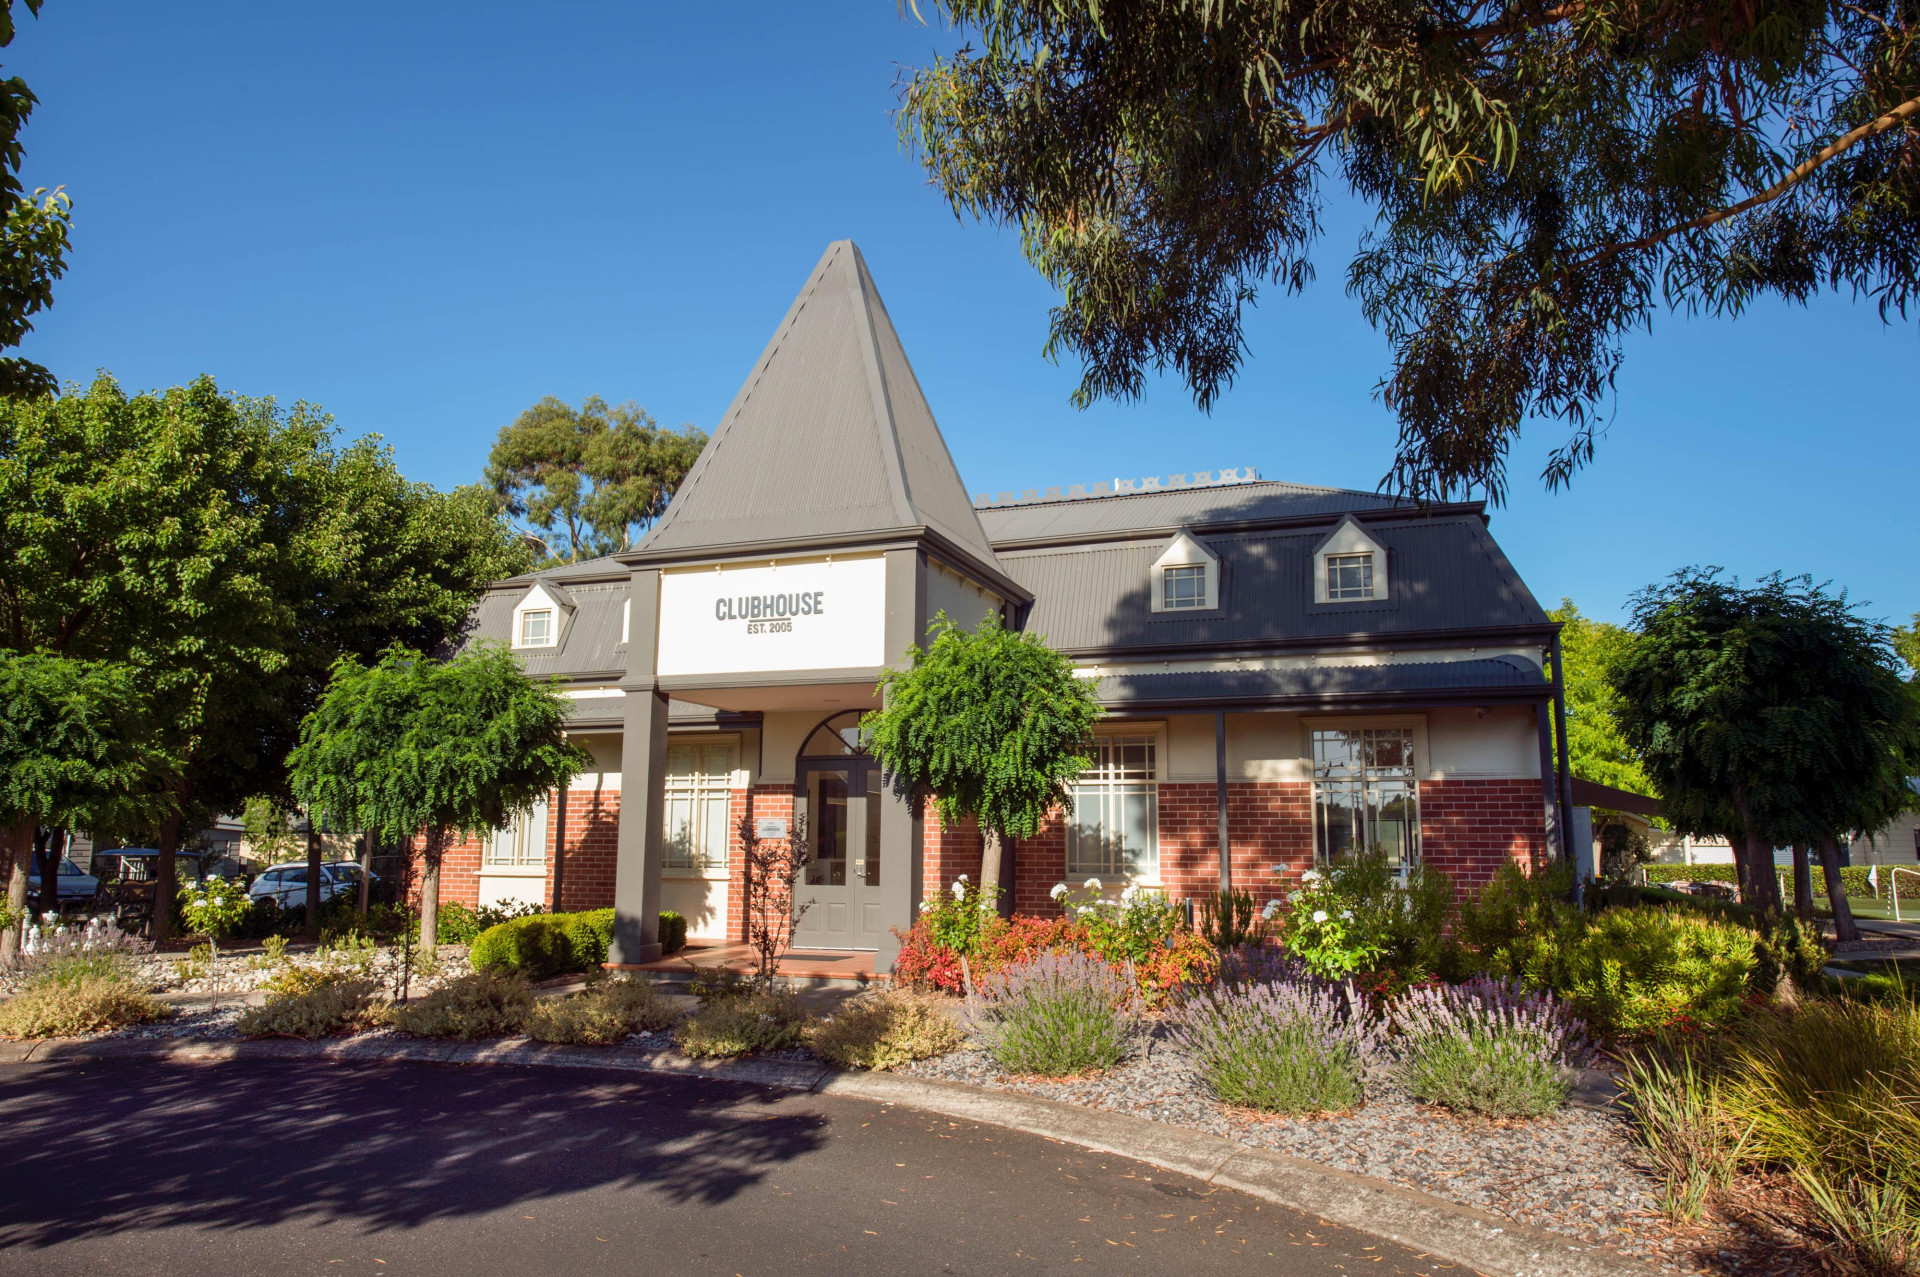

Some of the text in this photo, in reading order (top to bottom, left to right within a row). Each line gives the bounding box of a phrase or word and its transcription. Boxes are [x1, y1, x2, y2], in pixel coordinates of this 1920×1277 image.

[716, 592, 824, 620] CLUBHOUSE
[747, 622, 792, 634] EST. 2005
